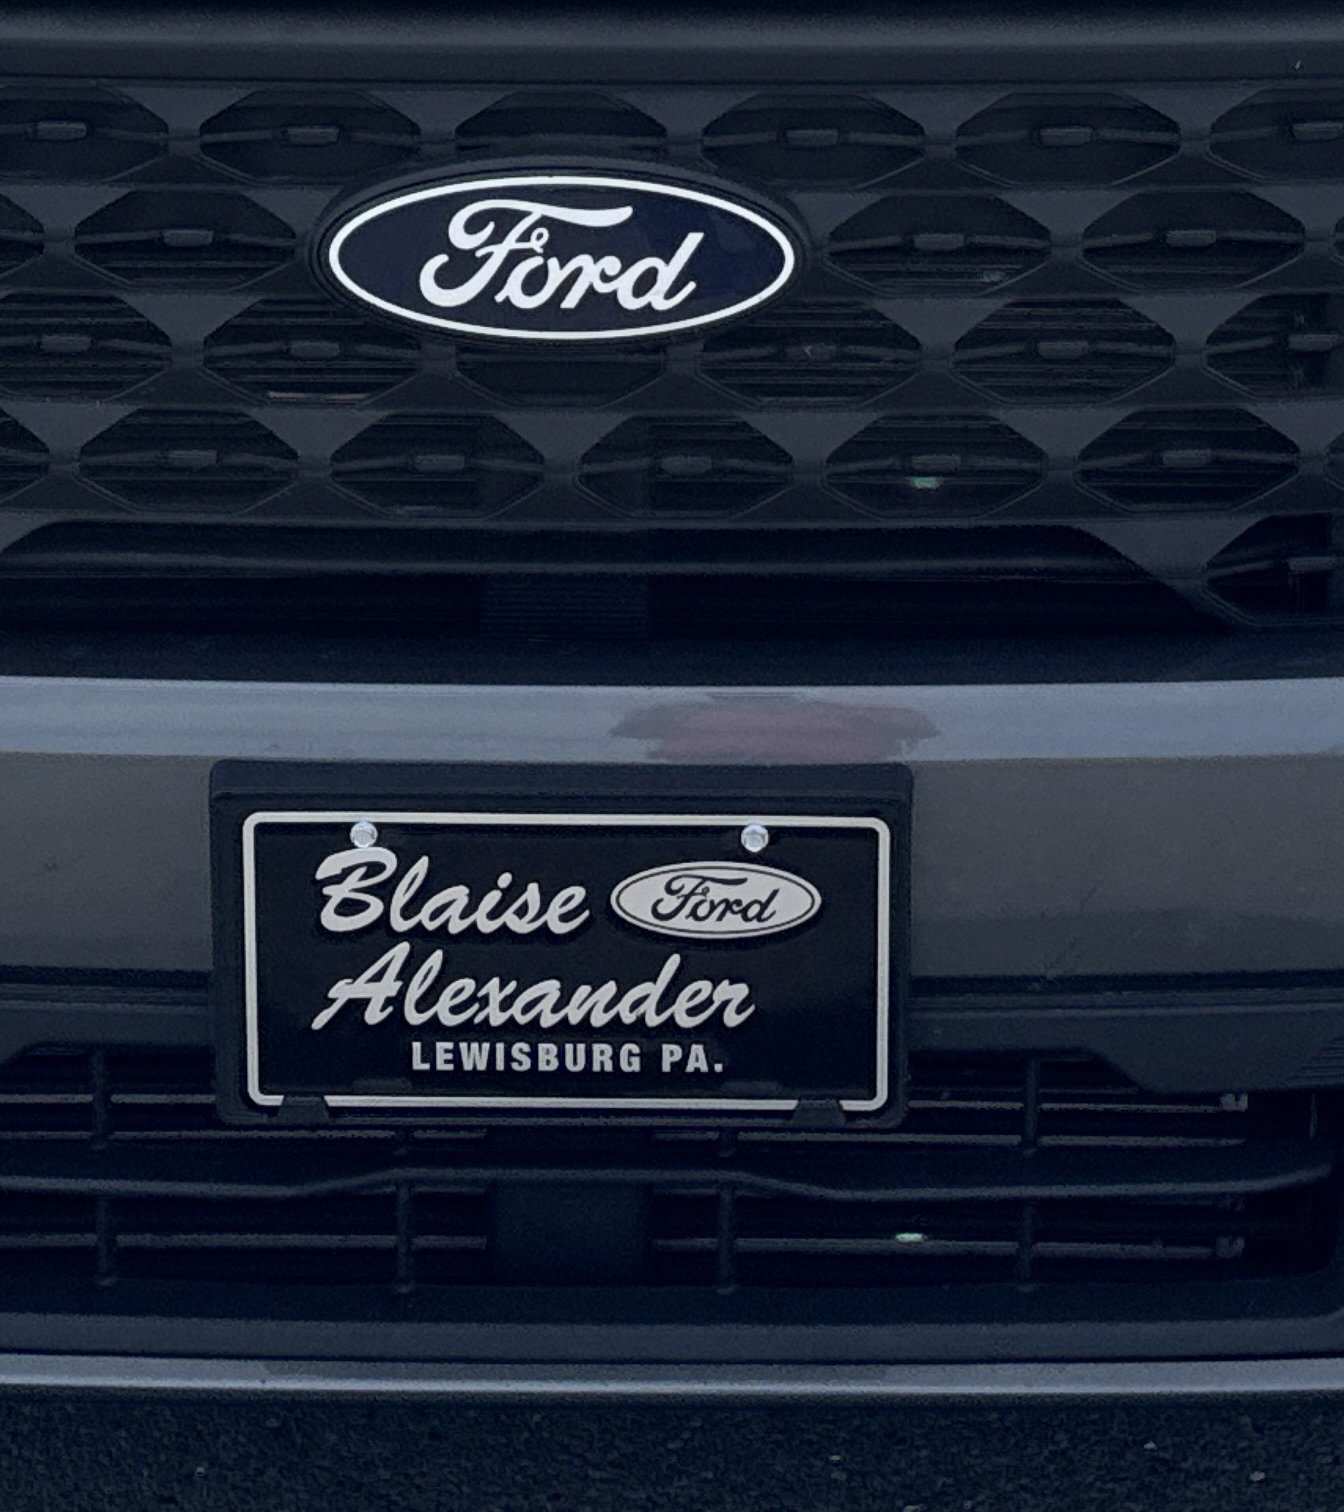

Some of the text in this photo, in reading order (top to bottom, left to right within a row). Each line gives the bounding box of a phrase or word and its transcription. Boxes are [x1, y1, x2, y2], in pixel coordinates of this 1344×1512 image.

[419, 199, 704, 311] Ford
[315, 847, 779, 934] Blaise Ford
[311, 941, 757, 1031] Alexander
[411, 1042, 725, 1074] LEWISBURG PA.
